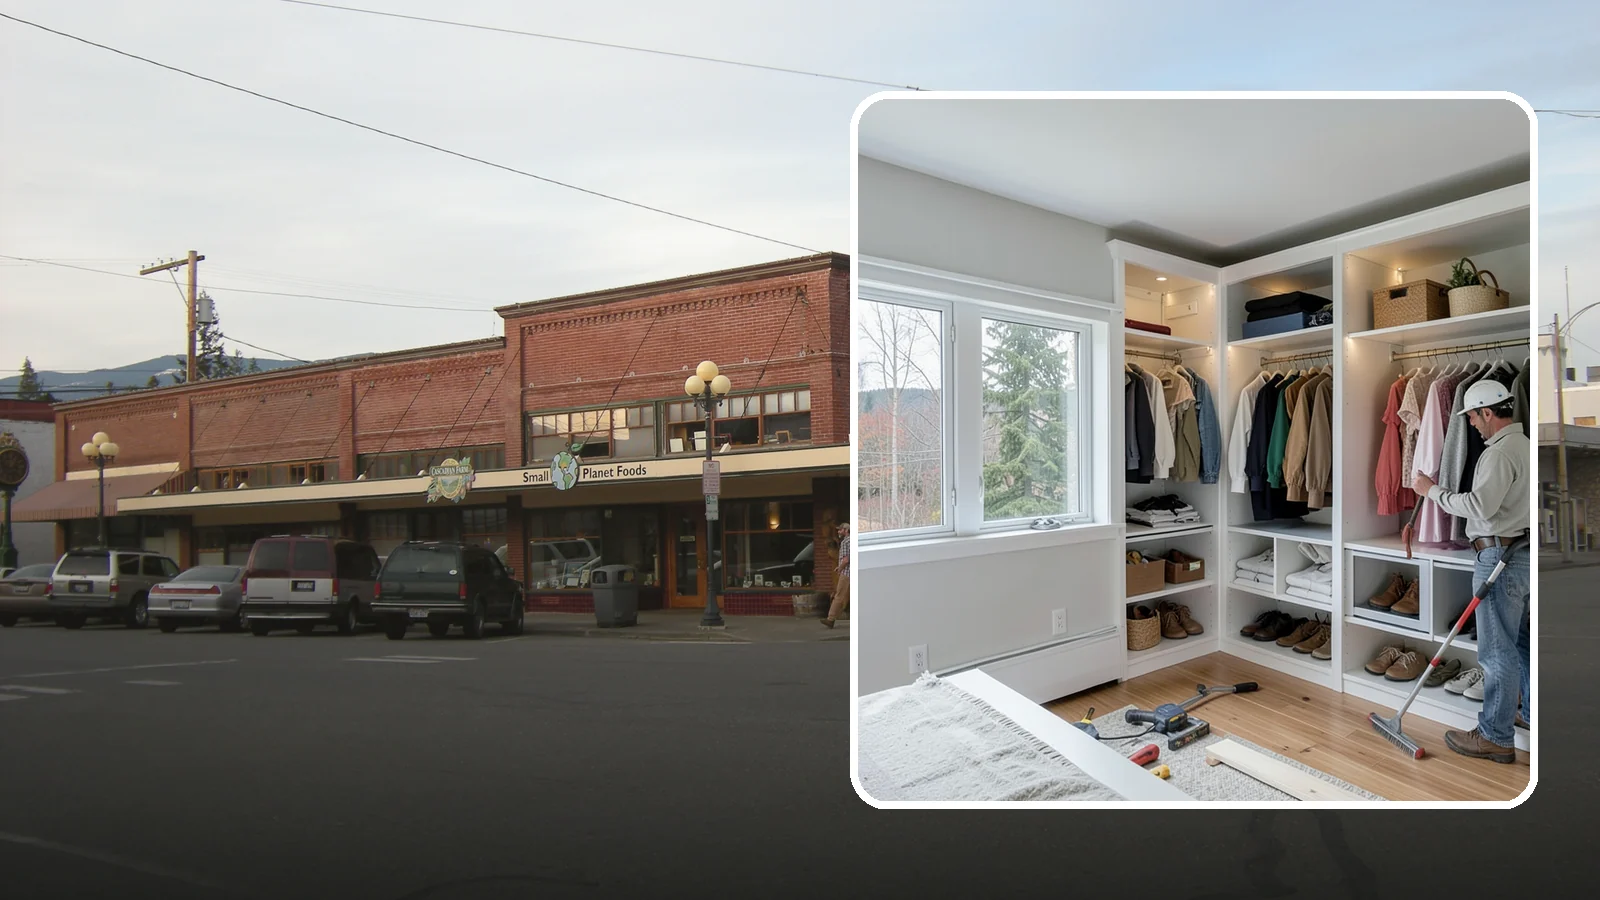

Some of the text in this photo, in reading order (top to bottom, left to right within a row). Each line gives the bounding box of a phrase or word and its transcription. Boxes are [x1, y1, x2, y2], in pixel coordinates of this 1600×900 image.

[523, 464, 647, 482] Small Planet Foods
